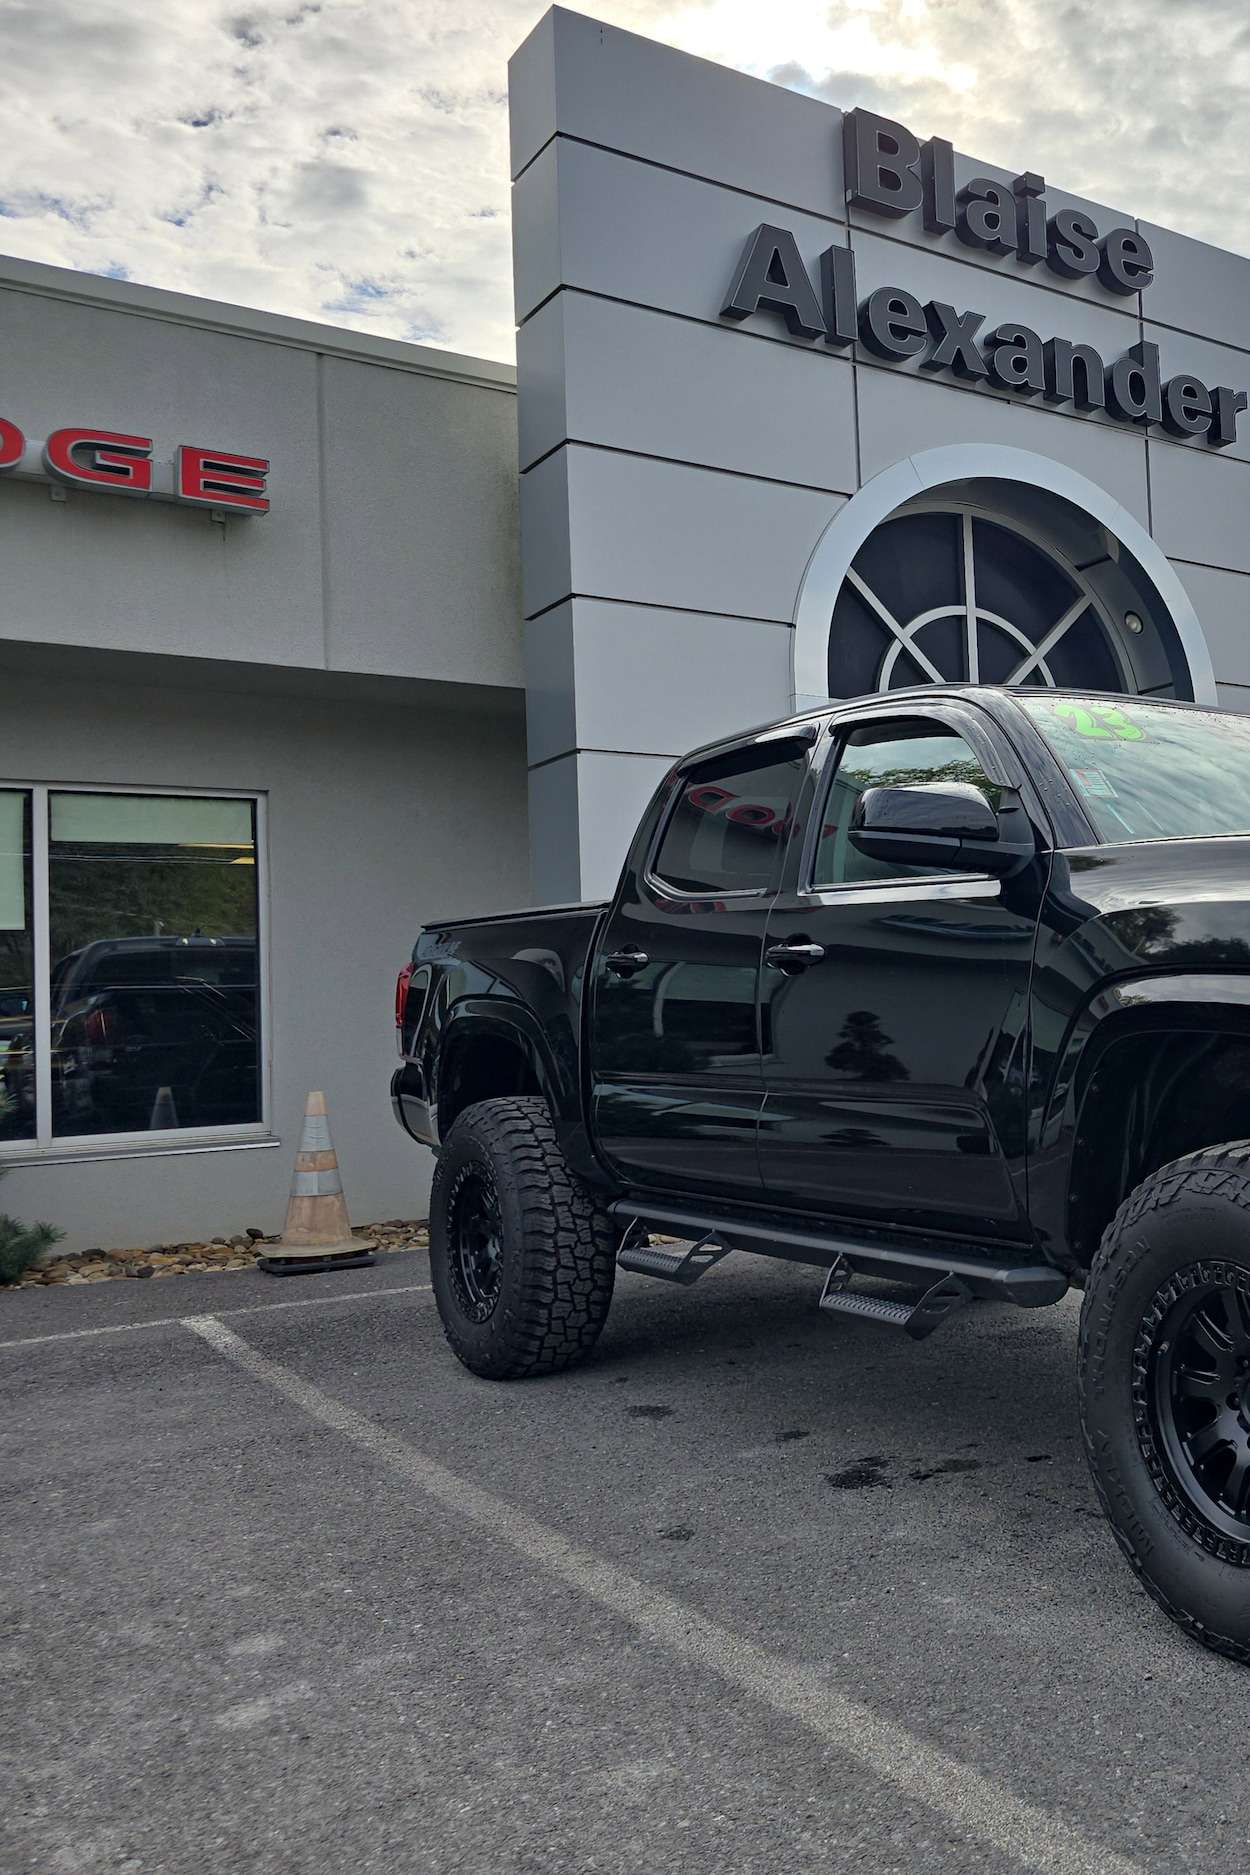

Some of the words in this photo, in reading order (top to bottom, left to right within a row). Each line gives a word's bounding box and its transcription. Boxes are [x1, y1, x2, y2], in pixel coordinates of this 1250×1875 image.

[843, 107, 1154, 296] Blaise
[720, 223, 1248, 447] Alexander
[0, 417, 270, 517] GE
[1054, 703, 1148, 742] 23
